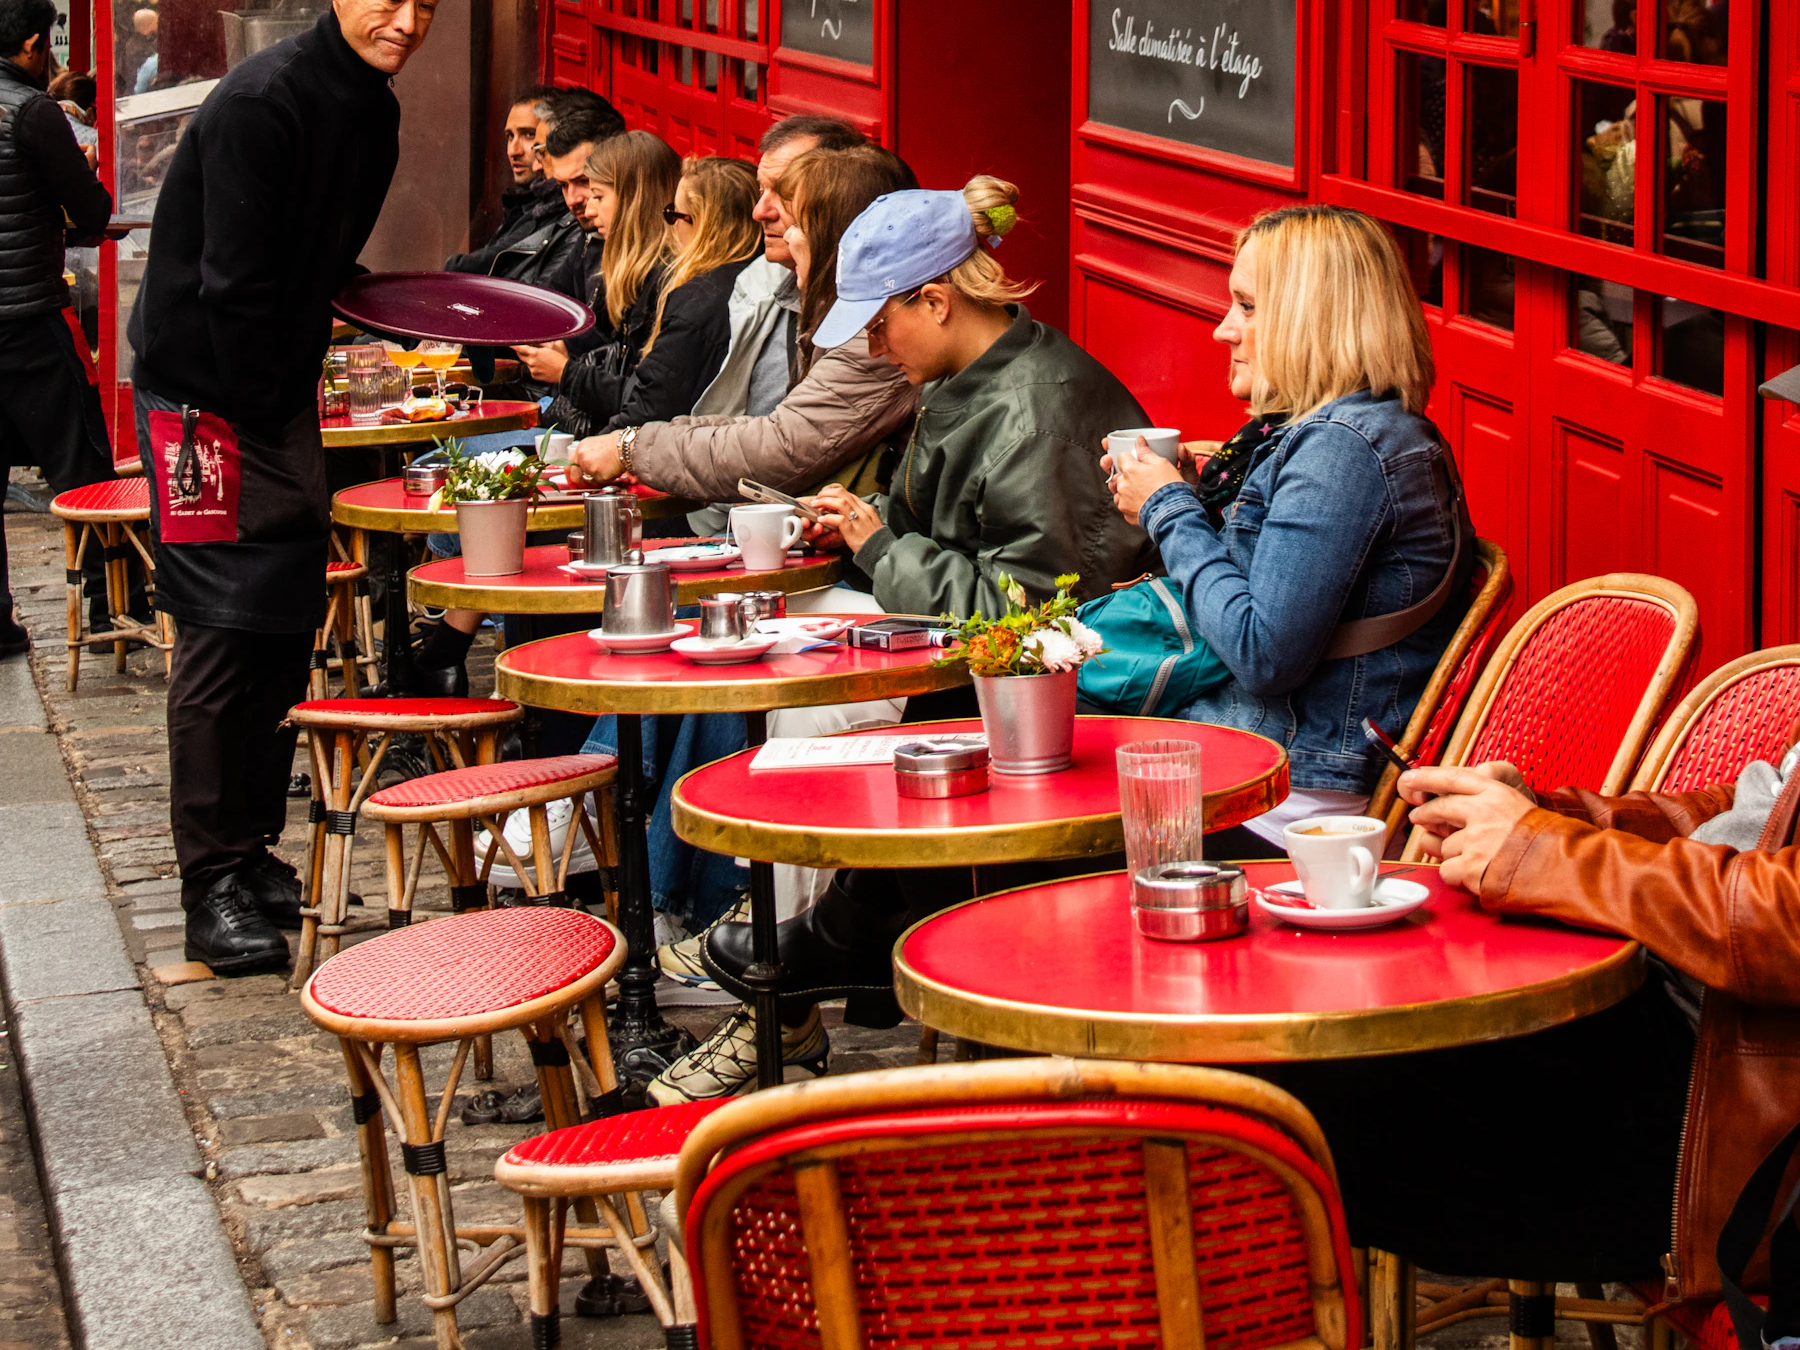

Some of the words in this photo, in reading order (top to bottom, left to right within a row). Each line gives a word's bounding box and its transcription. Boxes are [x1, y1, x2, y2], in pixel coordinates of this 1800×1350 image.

[1108, 7, 1137, 55] Salle
[1138, 19, 1193, 65] climatisée
[1195, 35, 1207, 68] à
[1209, 22, 1263, 100] l'étage
